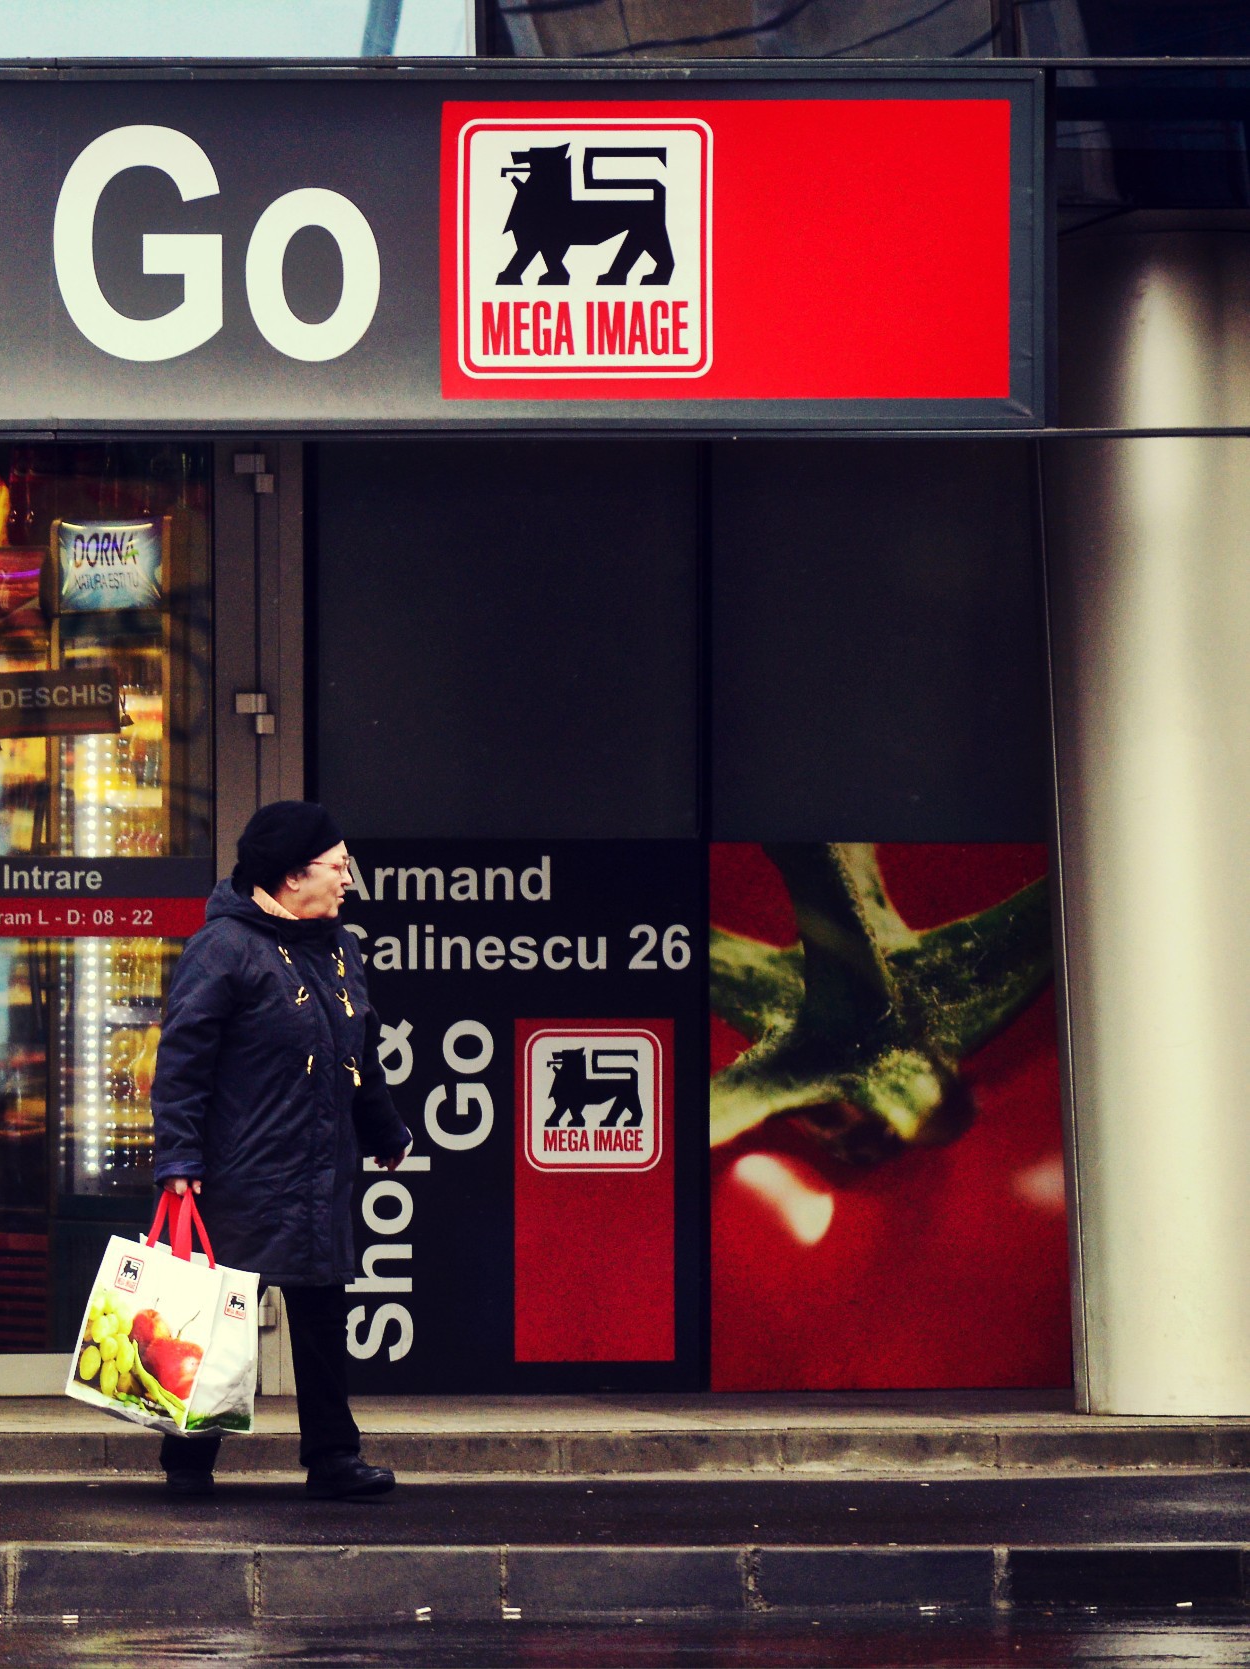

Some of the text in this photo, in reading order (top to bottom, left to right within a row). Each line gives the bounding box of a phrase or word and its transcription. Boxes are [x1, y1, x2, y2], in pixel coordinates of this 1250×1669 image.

[53, 124, 381, 362] Go
[481, 300, 689, 356] MEGA IMAGE
[0, 683, 113, 710] DESCHIS
[3, 864, 103, 890] Intrare
[345, 855, 550, 901] Armand
[38, 909, 49, 925] L
[67, 909, 86, 925] D:
[93, 909, 114, 925] 08
[132, 909, 153, 925] 22
[628, 924, 691, 971] 26
[424, 1019, 494, 1151] Go
[543, 1129, 644, 1153] MEGA IMAGE
